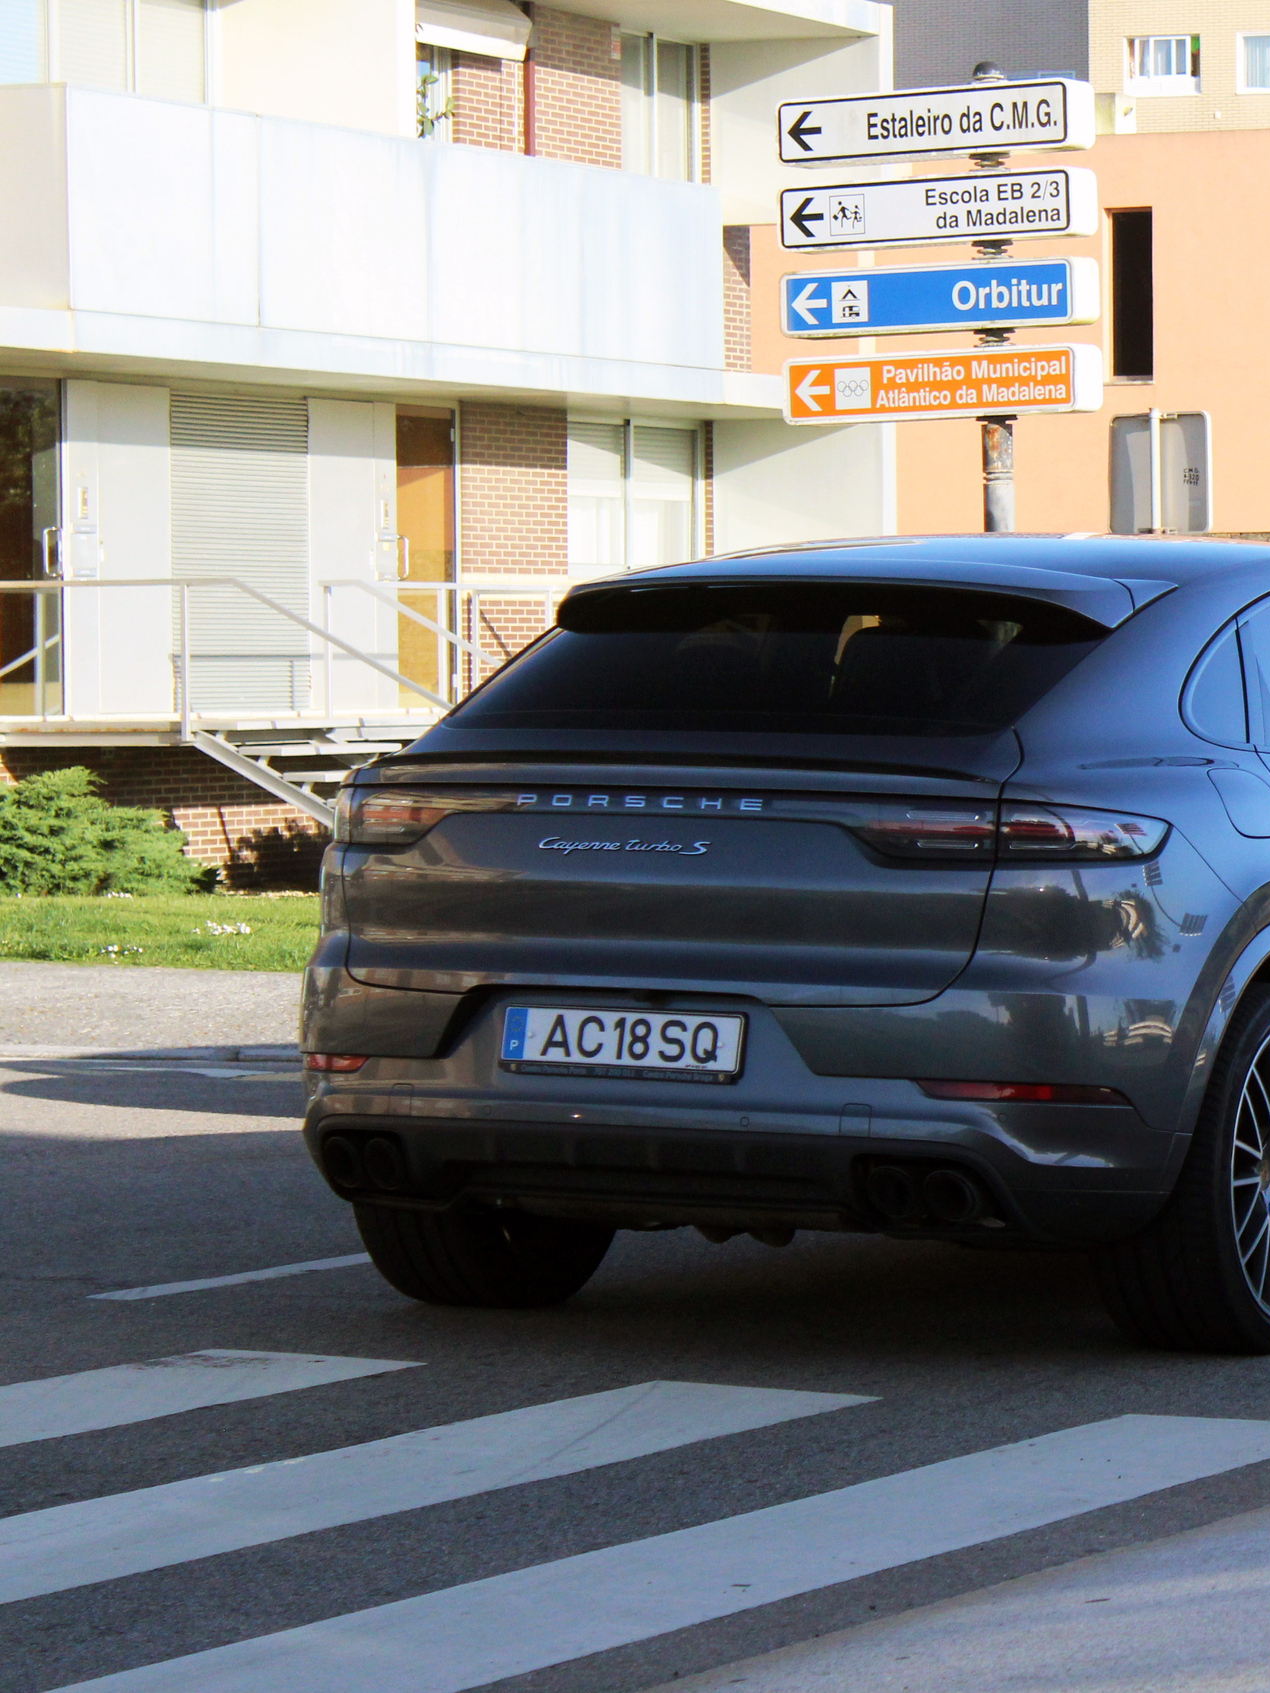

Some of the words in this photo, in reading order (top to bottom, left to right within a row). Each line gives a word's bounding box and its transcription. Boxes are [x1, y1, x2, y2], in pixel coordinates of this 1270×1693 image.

[867, 108, 952, 140] Estaleiro
[959, 105, 983, 134] da
[990, 98, 1058, 131] C.M.G.
[925, 185, 989, 206] Escola
[997, 183, 1023, 201] EB
[1030, 180, 1060, 201] 2/3
[936, 211, 959, 229] da
[966, 206, 1061, 227] Madalena
[952, 279, 1063, 311] Orbitur
[882, 361, 965, 384] Pavilhão
[971, 356, 1066, 380] Municipal
[875, 387, 951, 408] Atlântico
[956, 385, 977, 404] da
[982, 382, 1066, 403] Madalena
[516, 793, 763, 811] PORSCHE
[538, 836, 621, 855] Cayenne
[678, 841, 711, 855] S
[540, 1014, 719, 1064] AC18SQ
